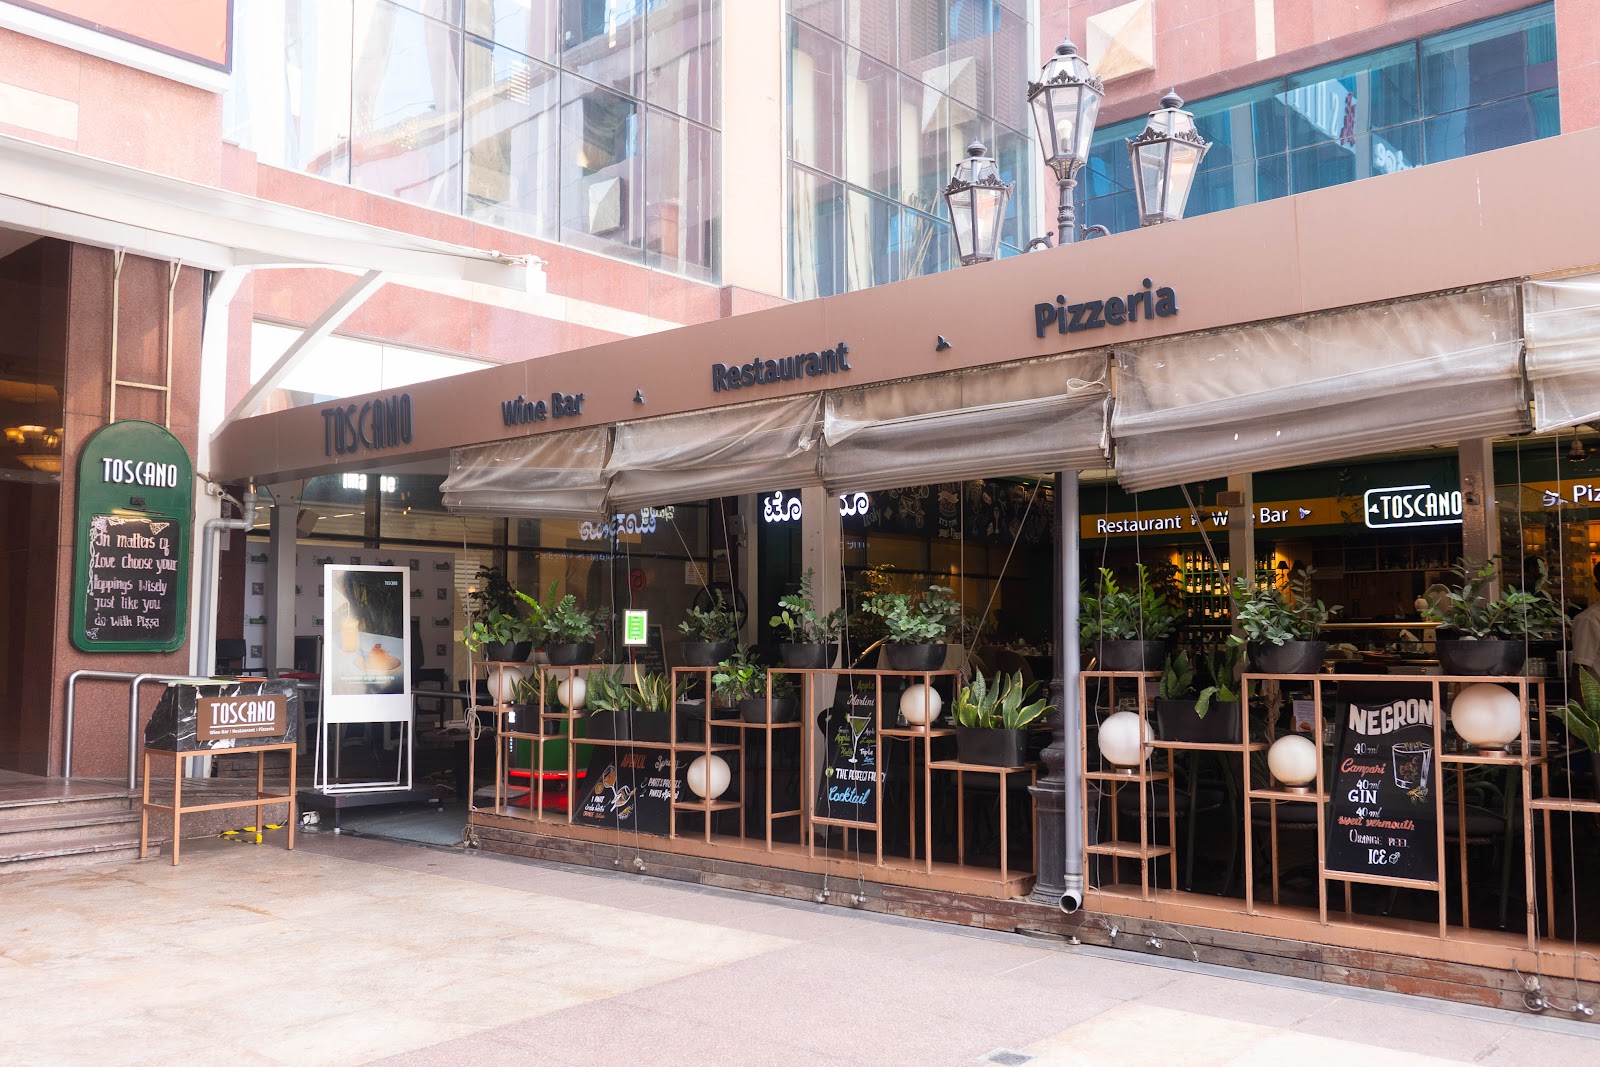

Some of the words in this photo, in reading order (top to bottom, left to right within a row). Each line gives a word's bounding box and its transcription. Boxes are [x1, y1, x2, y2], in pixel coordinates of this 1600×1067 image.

[1035, 278, 1179, 338] Pizzeria
[712, 342, 851, 392] Restaurant
[502, 395, 547, 426] Wine
[551, 391, 585, 418] Bar
[321, 393, 413, 457] TOSCANO
[101, 458, 178, 488] TOSCANO
[1380, 490, 1462, 520] TOSCANO
[1097, 515, 1182, 534] Restaurant
[1260, 507, 1289, 524] Bar
[96, 531, 111, 547] In
[117, 533, 156, 549] matters
[160, 537, 170, 556] of
[94, 552, 116, 568] Love
[156, 558, 178, 574] your
[121, 596, 139, 609] like
[142, 598, 161, 613] you
[137, 615, 160, 629] Pizza
[847, 693, 875, 706] Martini
[210, 700, 276, 725] TOSCANO
[1349, 698, 1434, 736] NEGRON
[836, 768, 849, 780] THE
[1341, 758, 1386, 777] Campari
[829, 786, 870, 804] Cocktail
[1348, 790, 1377, 804] GIN
[1366, 820, 1415, 831] vermouth
[1367, 849, 1388, 865] ICE
